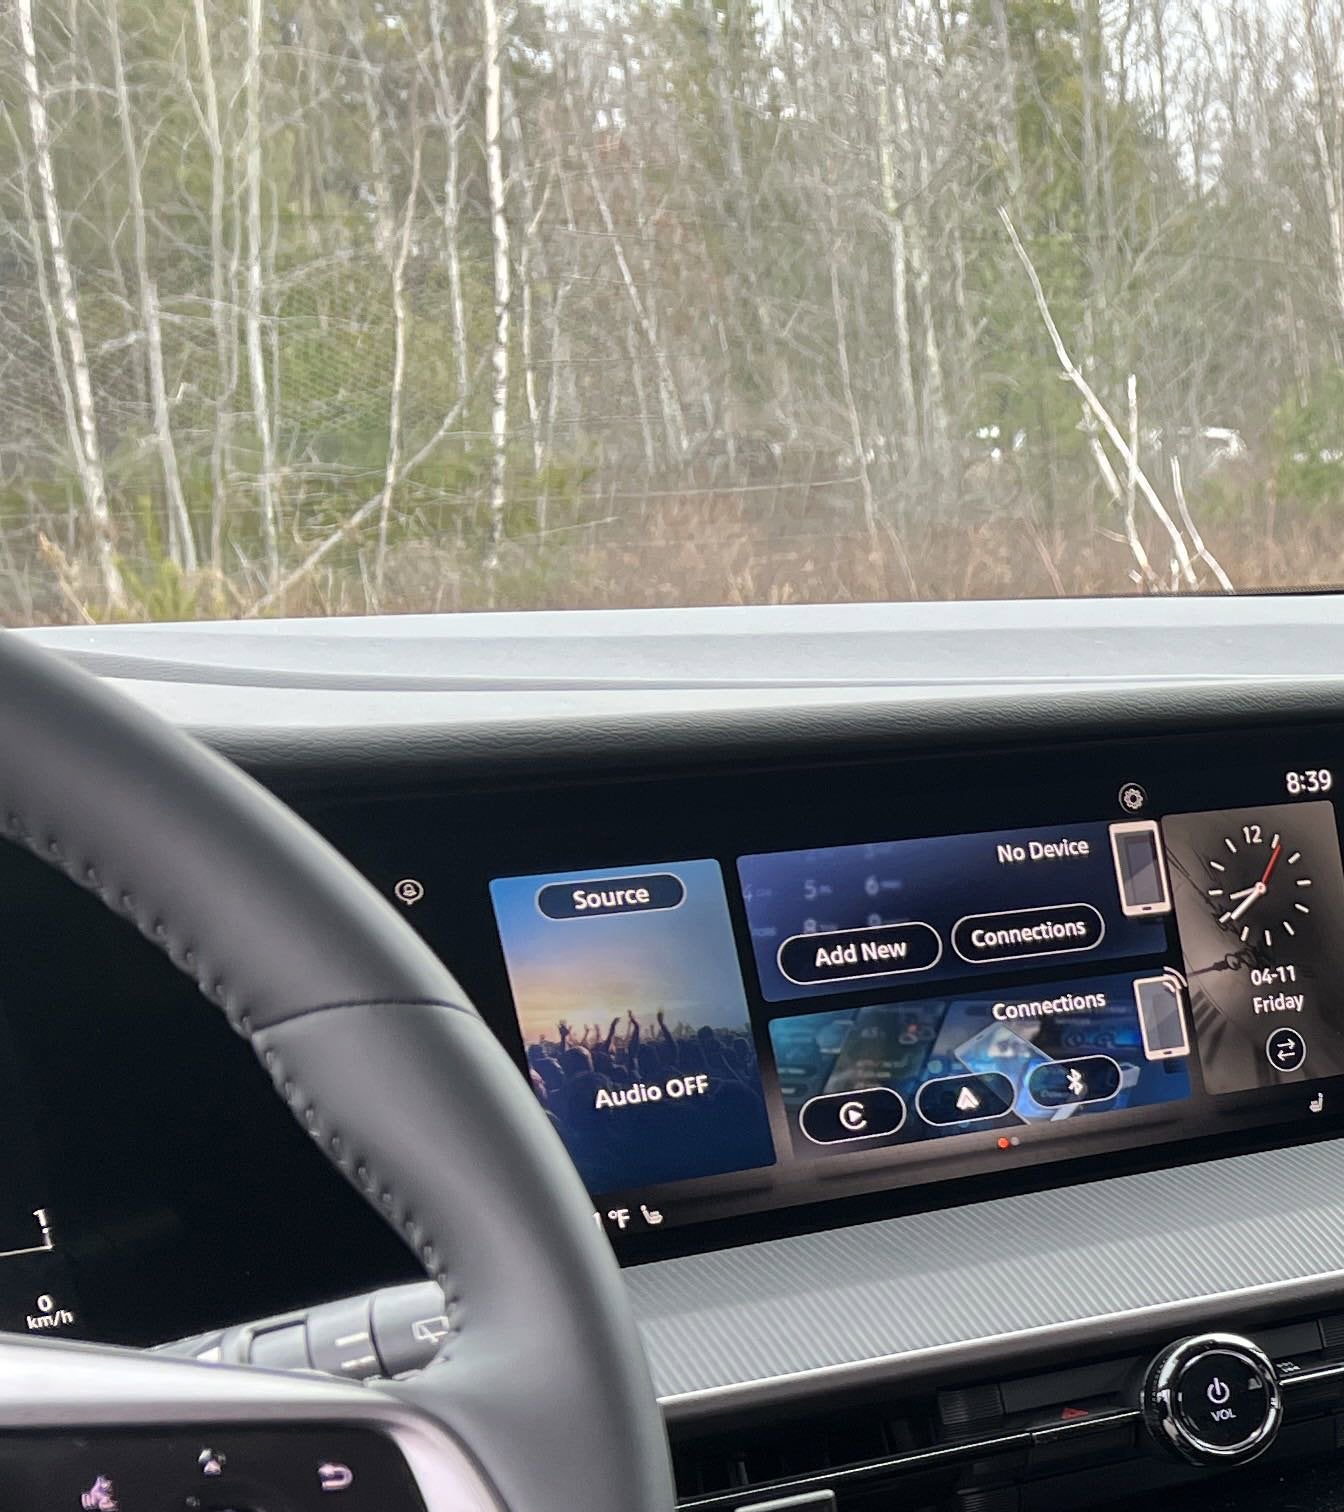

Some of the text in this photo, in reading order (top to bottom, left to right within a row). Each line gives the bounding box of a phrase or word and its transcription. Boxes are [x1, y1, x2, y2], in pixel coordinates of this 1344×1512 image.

[1286, 769, 1332, 794] 8:39
[1243, 825, 1263, 844] 12
[997, 838, 1089, 863] No Device
[572, 884, 650, 910] Source
[971, 920, 1086, 948] Connections
[814, 938, 907, 967] Add New
[1251, 965, 1296, 986] 04-11
[992, 992, 1106, 1022] Connections
[1253, 992, 1304, 1015] Friday
[595, 1074, 709, 1109] Audio OFF
[37, 1294, 53, 1312] 0
[27, 1309, 73, 1330] km/h
[1211, 1408, 1237, 1422] VOL
